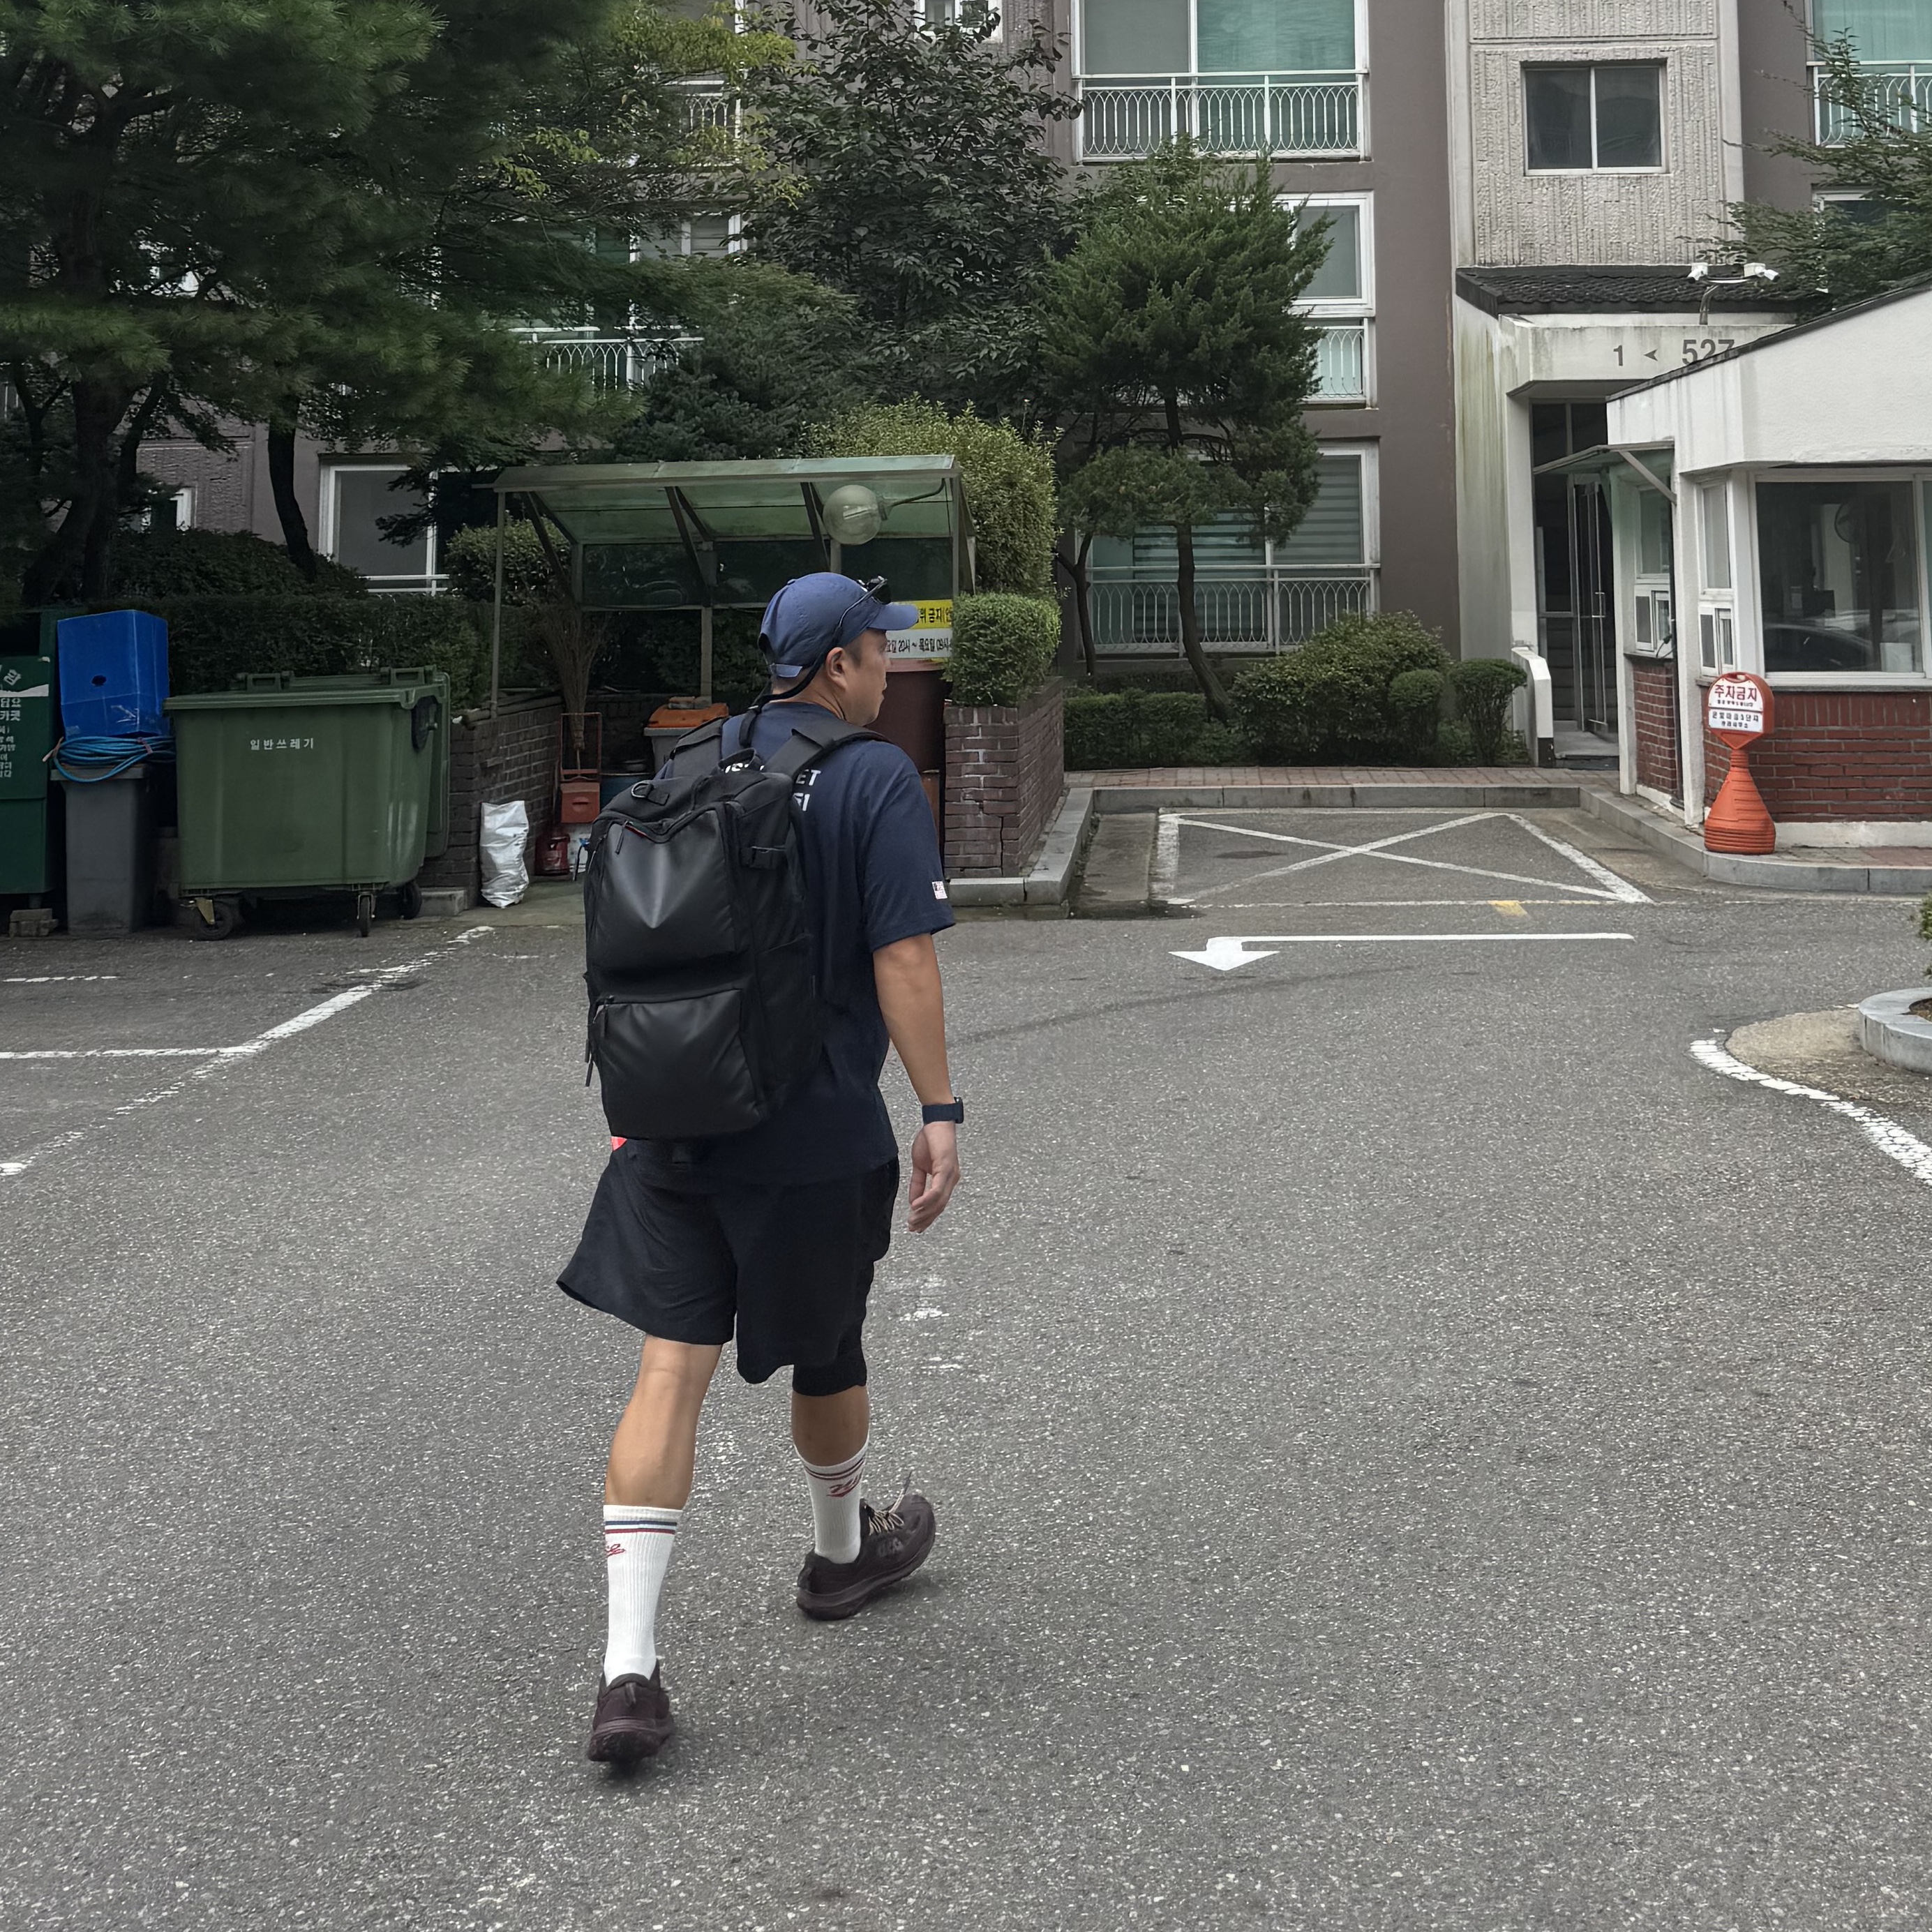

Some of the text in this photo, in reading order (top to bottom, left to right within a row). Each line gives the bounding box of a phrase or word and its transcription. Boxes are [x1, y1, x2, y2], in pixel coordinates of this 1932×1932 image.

[1613, 339, 1735, 366] 1 527
[1714, 684, 1757, 702] 주차금지
[250, 738, 313, 750] 일반쓰레기
